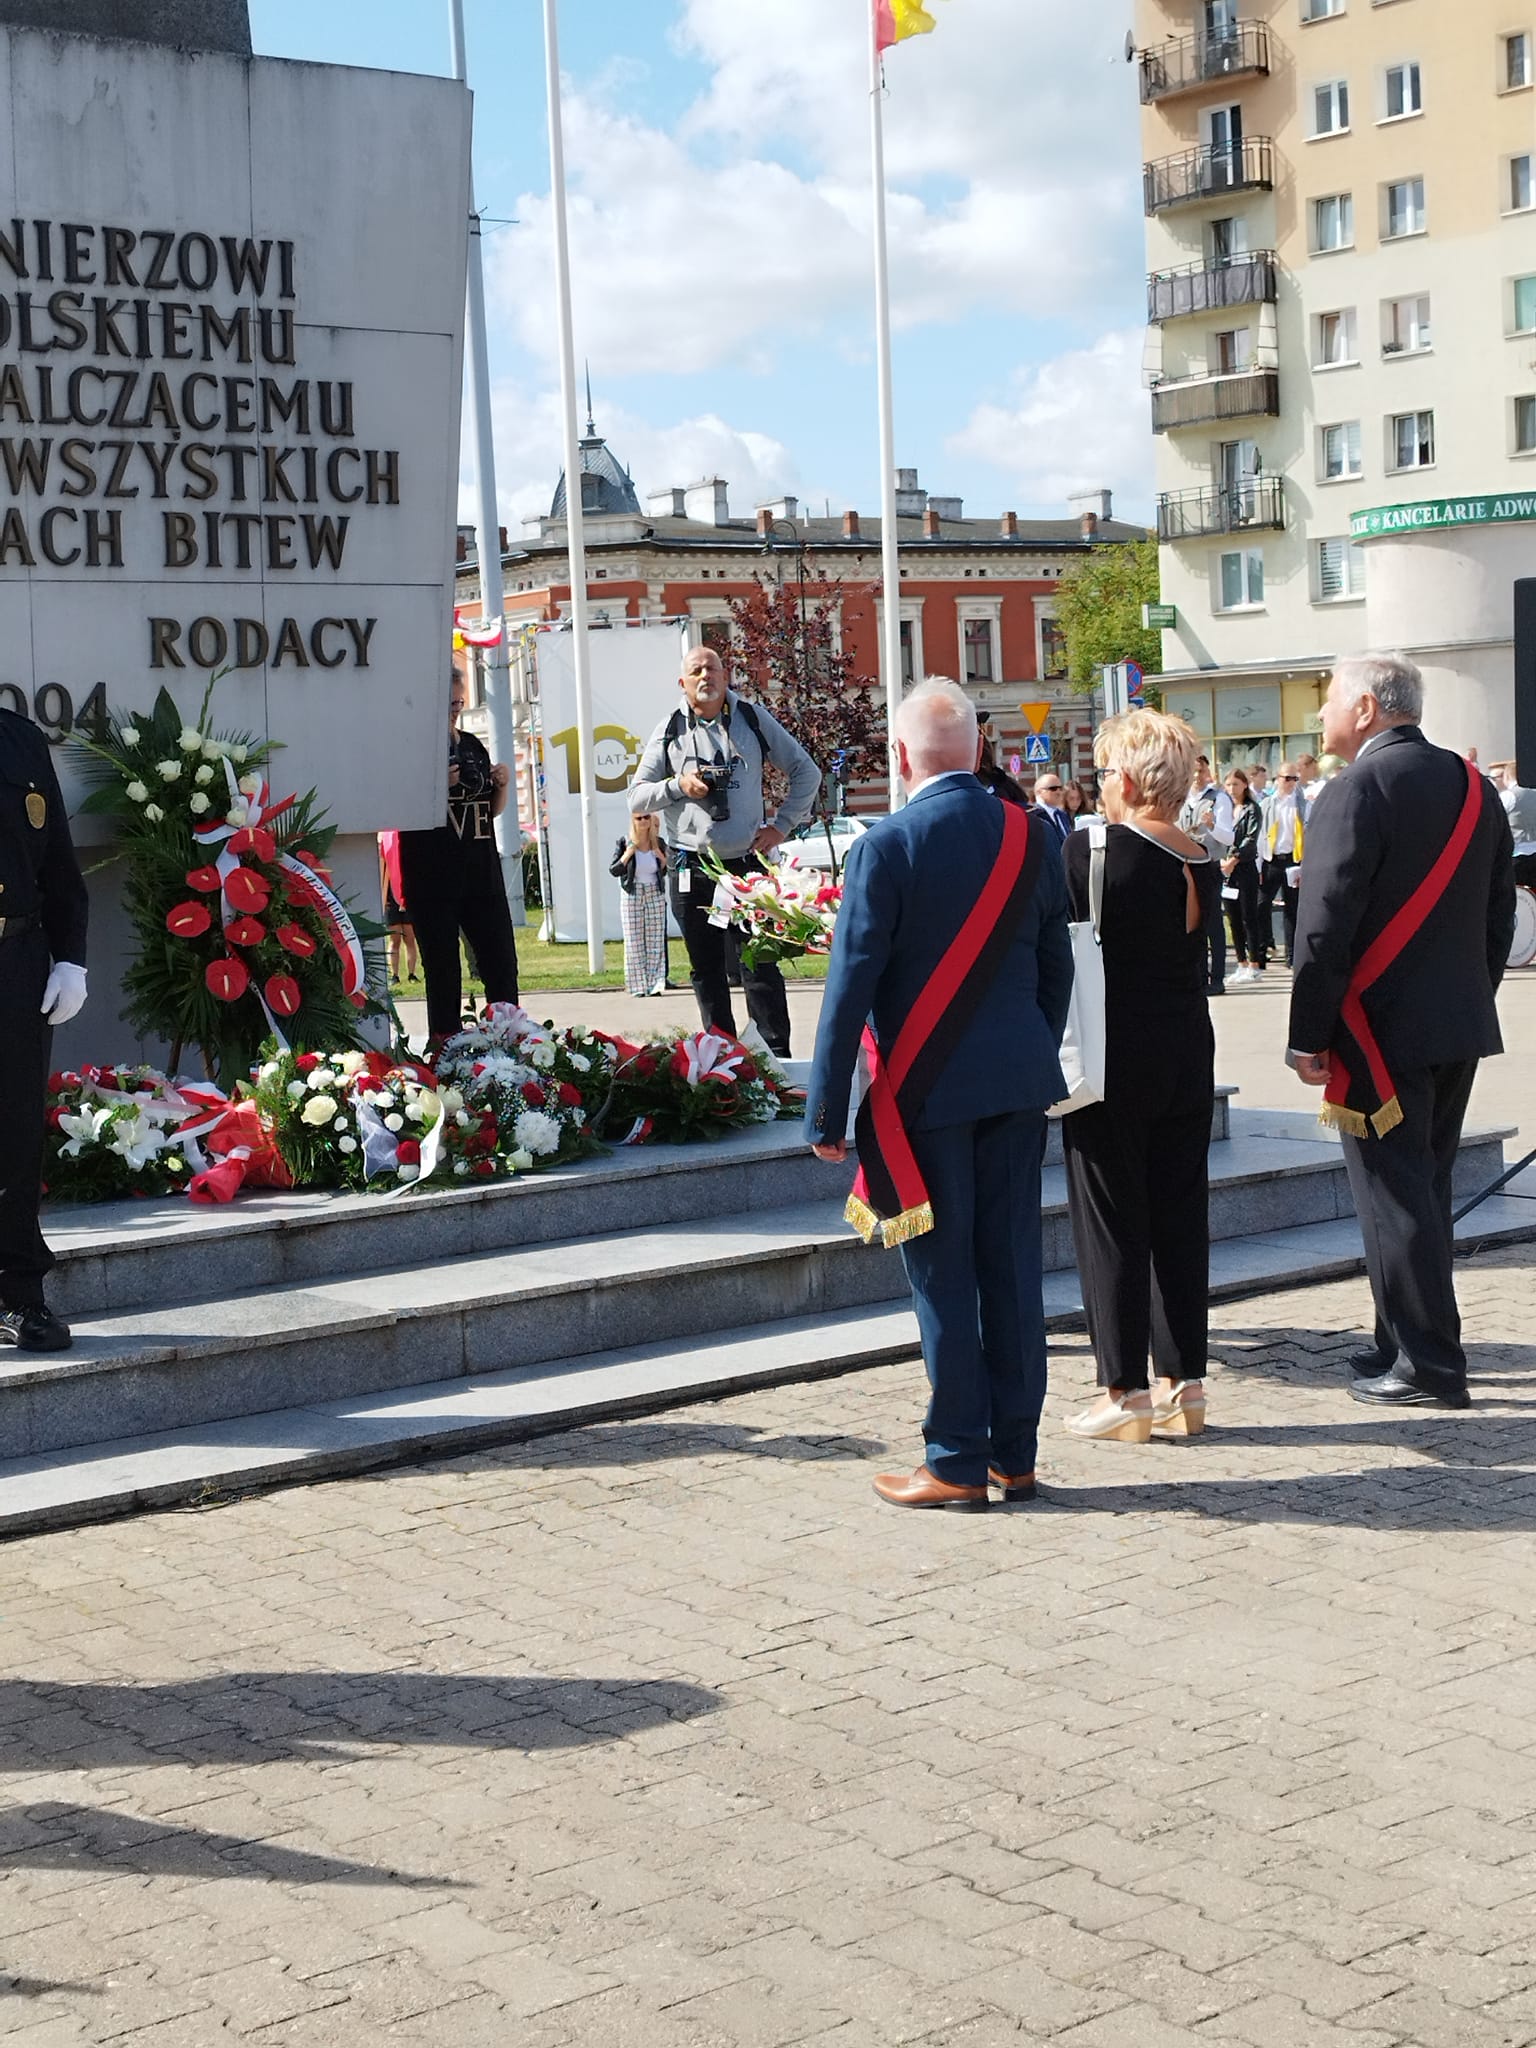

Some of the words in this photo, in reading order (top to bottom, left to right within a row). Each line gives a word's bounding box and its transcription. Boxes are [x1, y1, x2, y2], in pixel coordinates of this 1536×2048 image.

[0, 438, 400, 504] WSZYSTKICH
[0, 507, 124, 568] ACH
[162, 511, 351, 570] BITEW
[1382, 502, 1486, 529] KANCELARIE
[1491, 498, 1536, 517] ADW
[148, 616, 378, 668] RODACY
[597, 753, 622, 766] LAT
